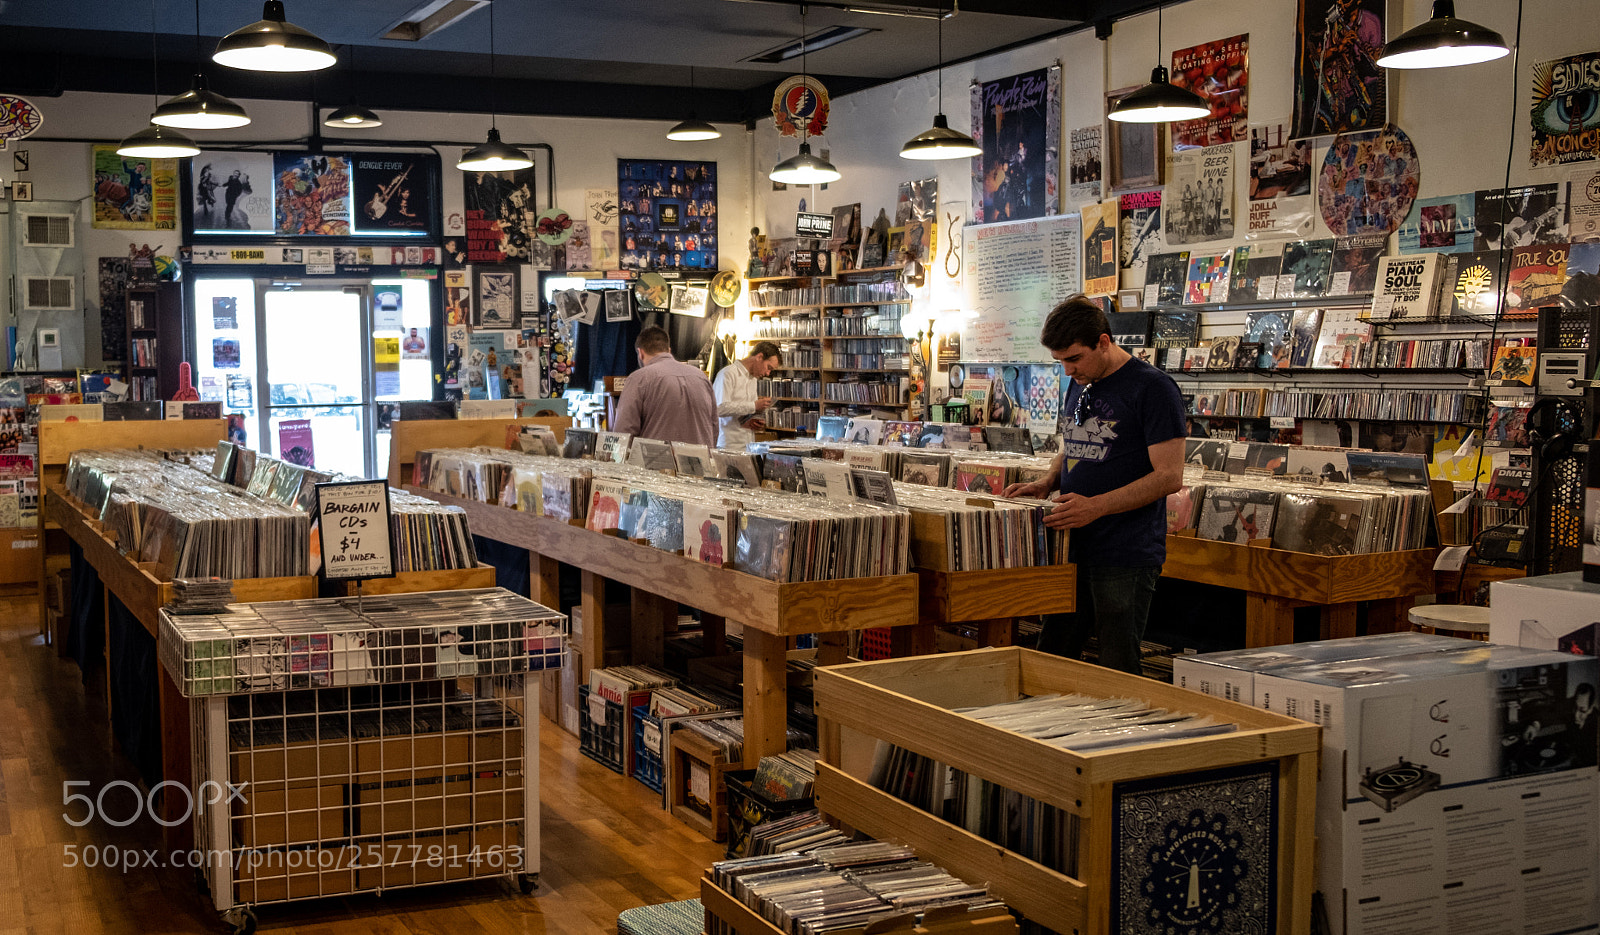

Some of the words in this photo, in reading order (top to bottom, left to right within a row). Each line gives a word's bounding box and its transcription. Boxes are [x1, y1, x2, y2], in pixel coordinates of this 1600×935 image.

[1173, 57, 1212, 72] FLOATING
[1215, 50, 1246, 62] COFFIN
[984, 77, 1021, 117] Purple
[1201, 144, 1233, 156] GROCERIES
[359, 161, 383, 170] DENGUE
[383, 162, 403, 170] FEVER
[1203, 156, 1229, 167] BEER
[1203, 166, 1229, 178] WINE
[1121, 191, 1161, 206] RAMONES
[1249, 211, 1270, 221] RUFF
[811, 219, 832, 230] PRINE
[1249, 219, 1276, 230] DRAFT
[977, 227, 996, 240] NEW
[468, 240, 487, 250] BUY
[1516, 252, 1541, 267] TRUE
[1546, 248, 1569, 266] SOU
[1386, 265, 1424, 277] PIANO
[1384, 275, 1422, 289] SOUL
[1322, 328, 1369, 337] DAVIS
[605, 435, 620, 443] NOW
[1065, 442, 1108, 460] RSEMEN
[595, 484, 605, 492] BURN
[605, 485, 615, 493] YOUR
[323, 501, 380, 515] BARGAIN
[339, 516, 368, 528] CDs
[340, 536, 360, 553] $4
[330, 554, 346, 563] AND
[598, 681, 622, 705] Annie
[1163, 830, 1207, 862] LANDLOCKED
[1207, 832, 1228, 852] MUSIC
